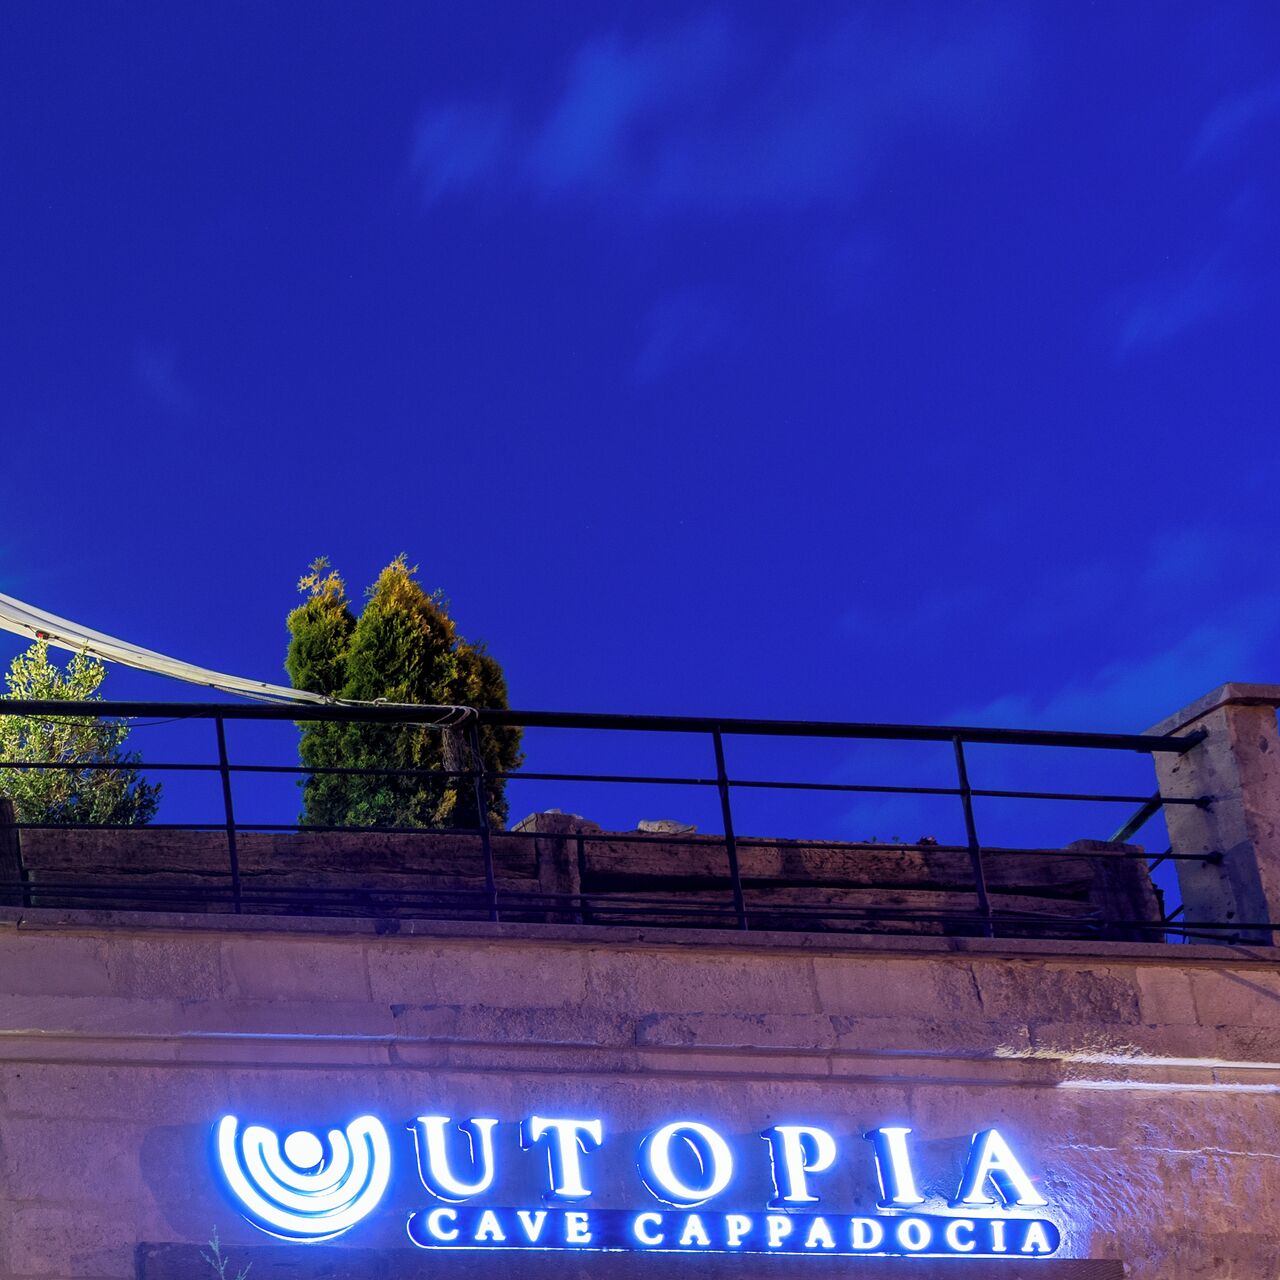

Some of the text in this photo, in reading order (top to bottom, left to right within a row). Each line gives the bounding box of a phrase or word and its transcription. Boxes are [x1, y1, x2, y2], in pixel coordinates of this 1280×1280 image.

[413, 1115, 1050, 1208] UTOPIA
[427, 1208, 1051, 1253] CAVE CAPPADOCIA
